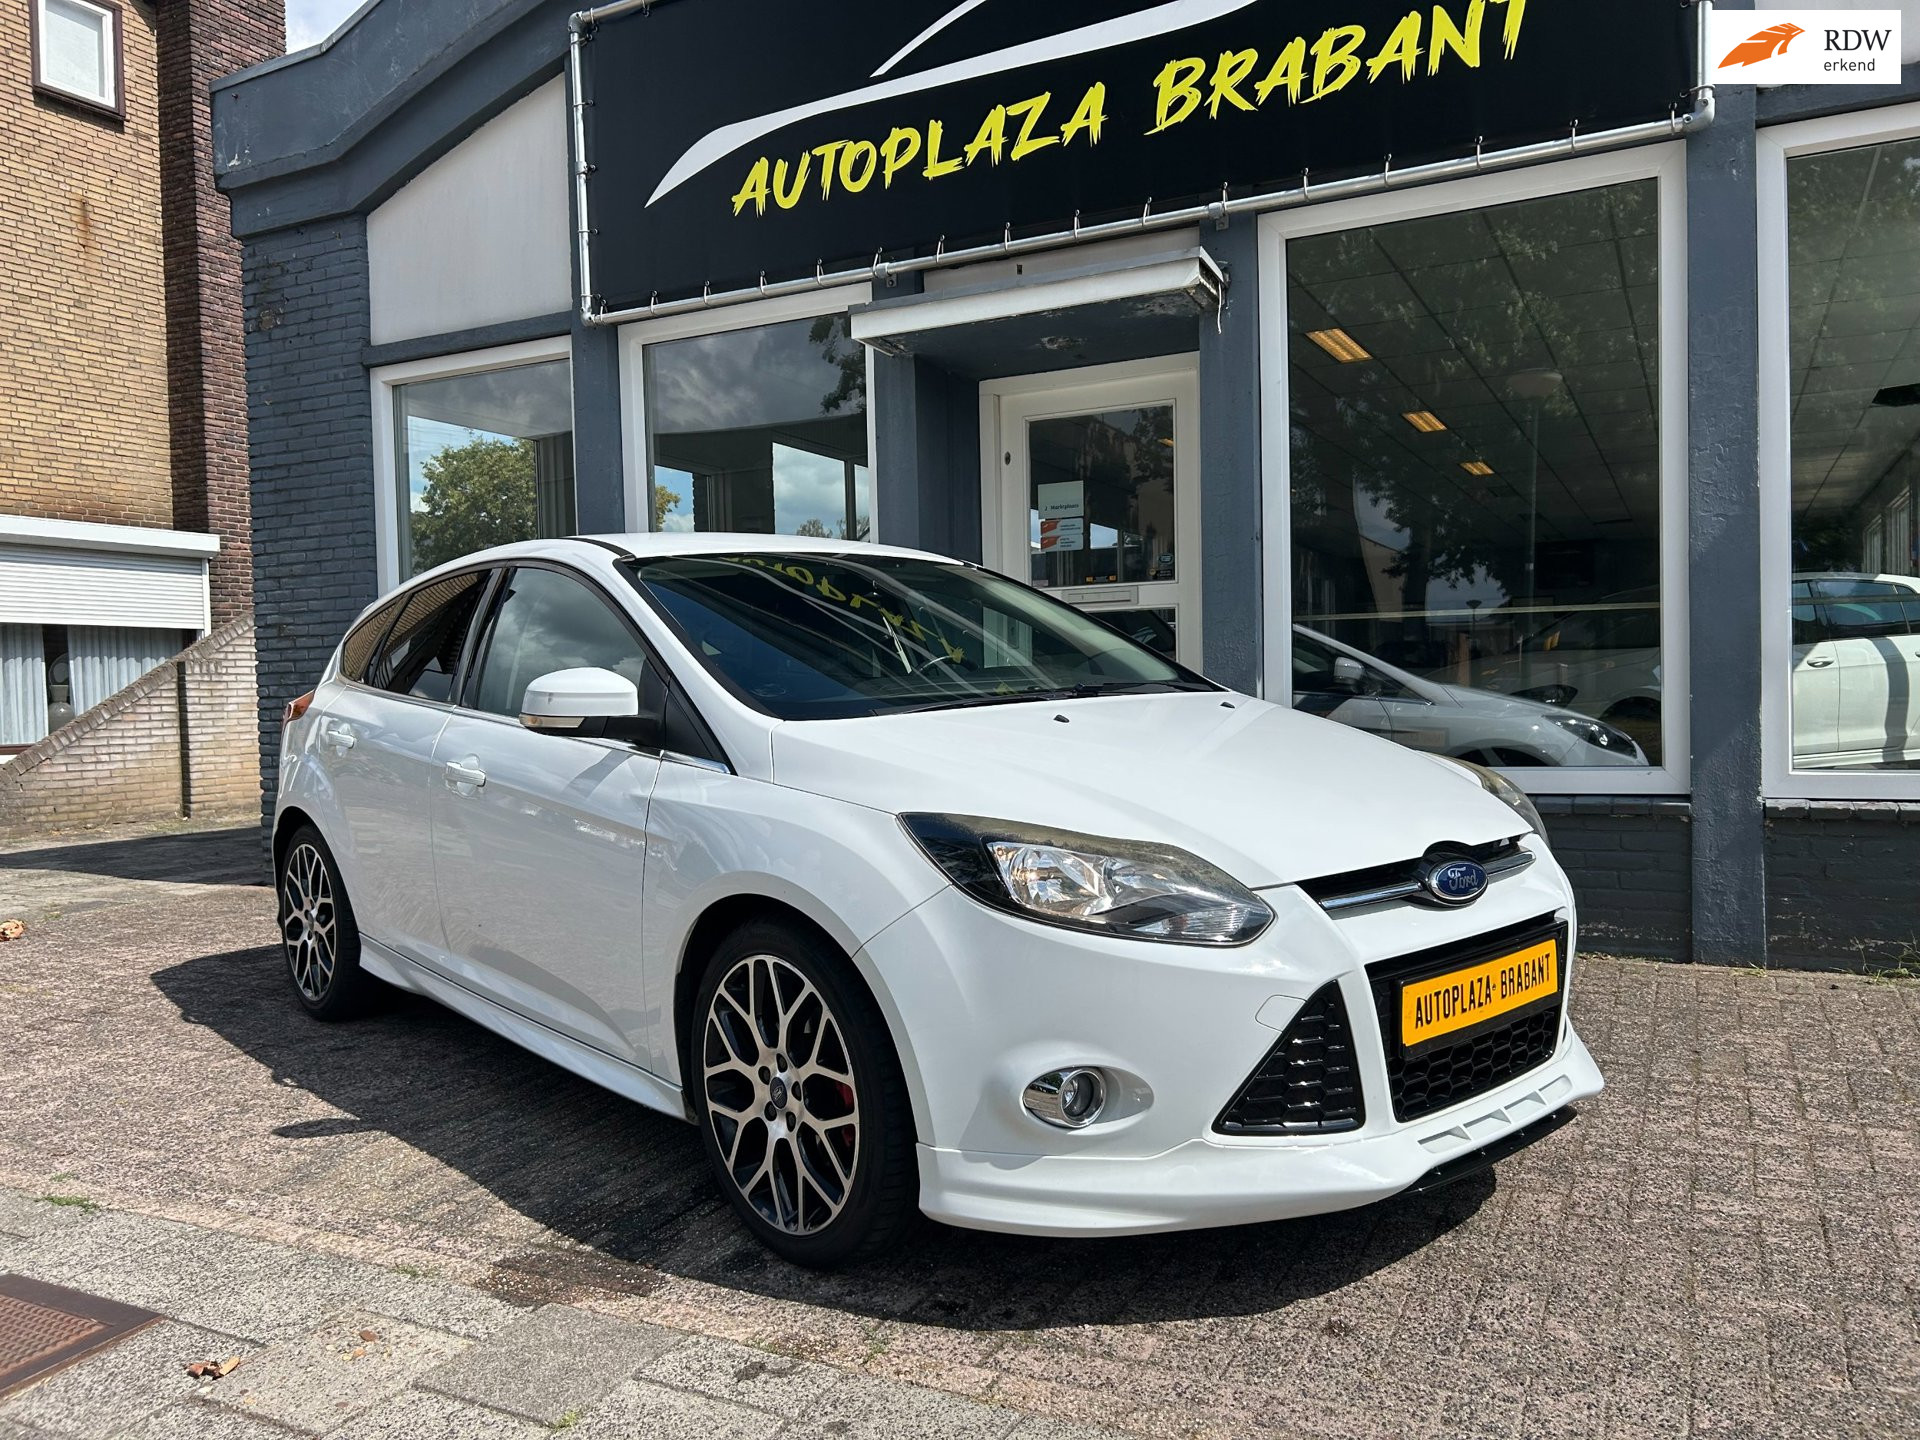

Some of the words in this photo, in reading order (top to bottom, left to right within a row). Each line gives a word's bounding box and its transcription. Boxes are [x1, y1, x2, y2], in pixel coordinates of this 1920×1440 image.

[732, 82, 1107, 217] AUTOPLAZA
[1143, 0, 1527, 135] BRABANT
[1447, 866, 1479, 891] Ford
[1414, 974, 1492, 1030] AUTOPLAZA
[1500, 953, 1551, 1000] BRABANT
